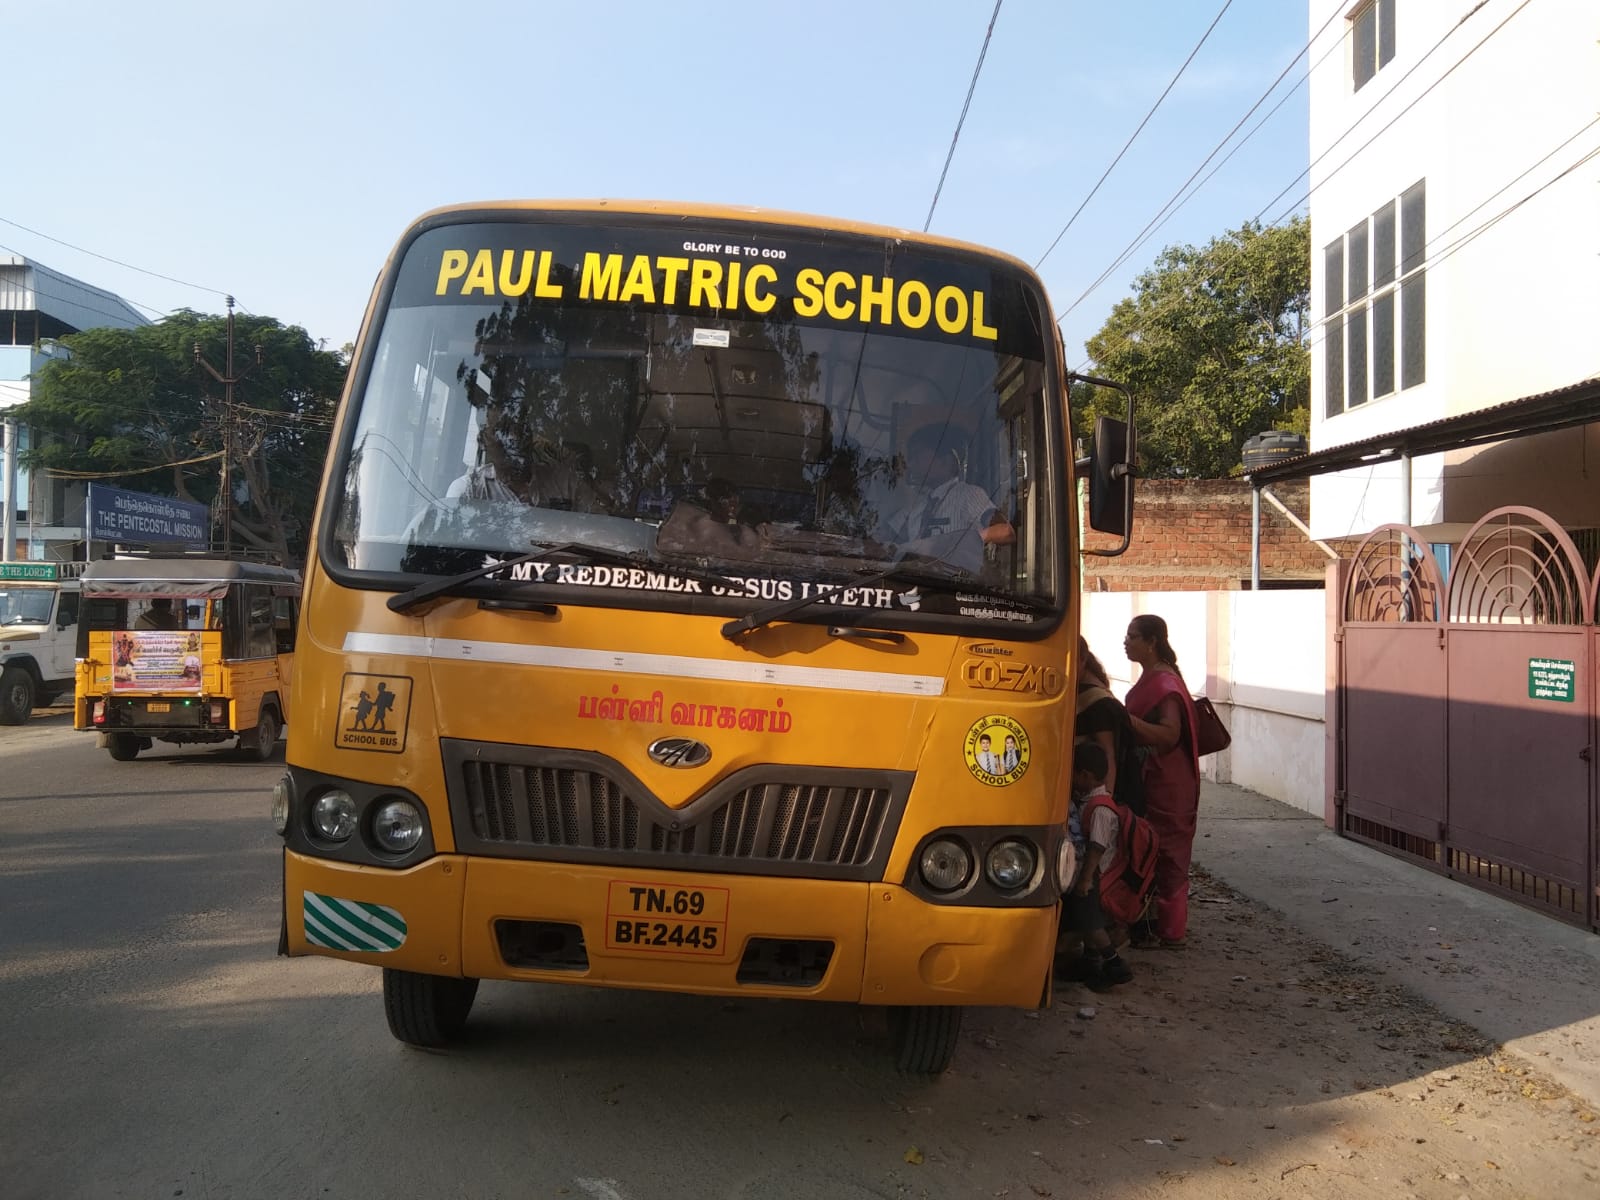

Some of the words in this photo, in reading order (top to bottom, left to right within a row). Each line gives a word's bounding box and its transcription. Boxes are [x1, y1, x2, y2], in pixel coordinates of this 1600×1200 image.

[683, 241, 722, 253] GLORY
[725, 245, 740, 255] BE
[743, 246, 759, 257] TO
[761, 249, 787, 259] GOD
[435, 249, 563, 298] PAUL
[578, 252, 778, 313] MATRIC
[793, 268, 998, 340] SCHOOL
[98, 510, 116, 527] THE
[118, 513, 173, 535] PENTECOSTAL
[174, 520, 203, 539] MISSION
[6, 567, 21, 576] THE
[24, 567, 45, 577] LORD
[510, 562, 551, 582] MY
[556, 563, 703, 593] REDEEMER
[961, 658, 1061, 695] COSMO
[577, 684, 664, 724] பள்ளி
[670, 697, 792, 734] வாகனம்
[343, 734, 377, 745] SCHOOL
[380, 737, 398, 746] BUS
[970, 763, 1010, 785] SCHOOL
[1011, 760, 1027, 780] BUS
[629, 887, 705, 916] TN.69
[615, 920, 718, 950] BF.2445
